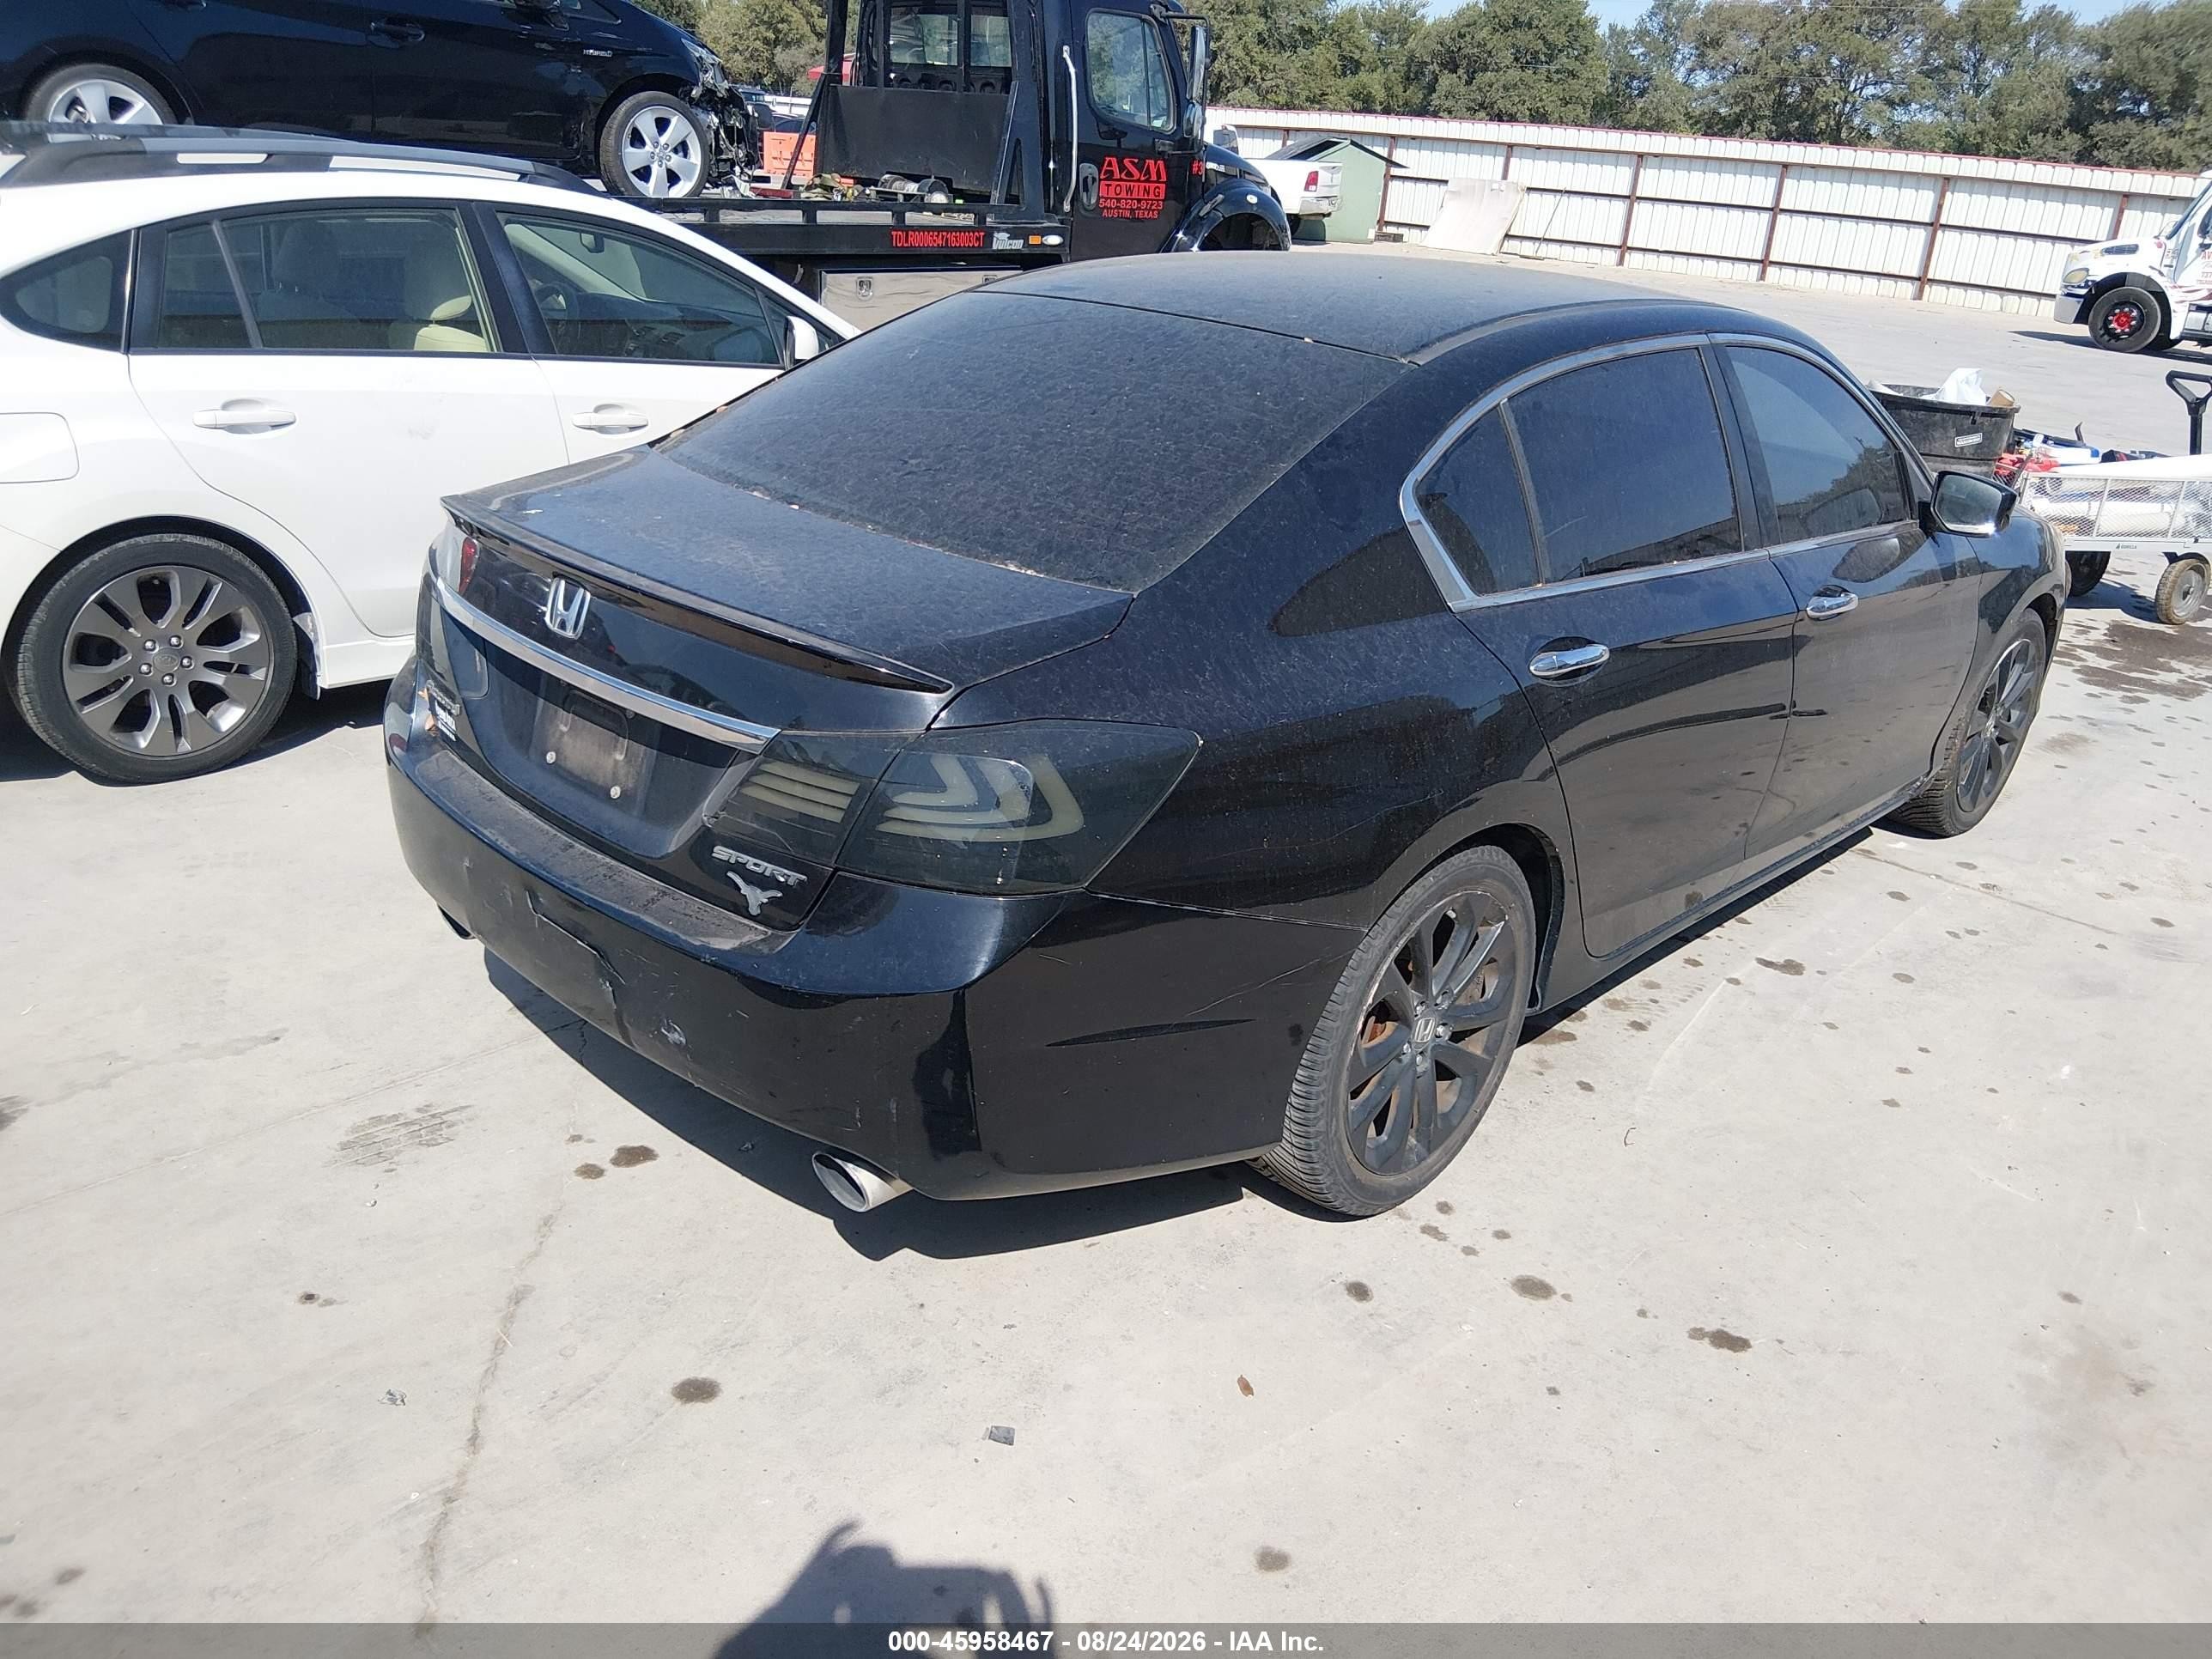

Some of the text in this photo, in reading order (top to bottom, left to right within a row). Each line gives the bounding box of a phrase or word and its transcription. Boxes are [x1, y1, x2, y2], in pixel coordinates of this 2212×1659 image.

[1099, 156, 1167, 182] ASM
[1104, 182, 1163, 198] TOWING
[1098, 198, 1164, 210] 540-820-9723
[1134, 210, 1159, 219] TEXAS
[711, 845, 808, 887] SPORT
